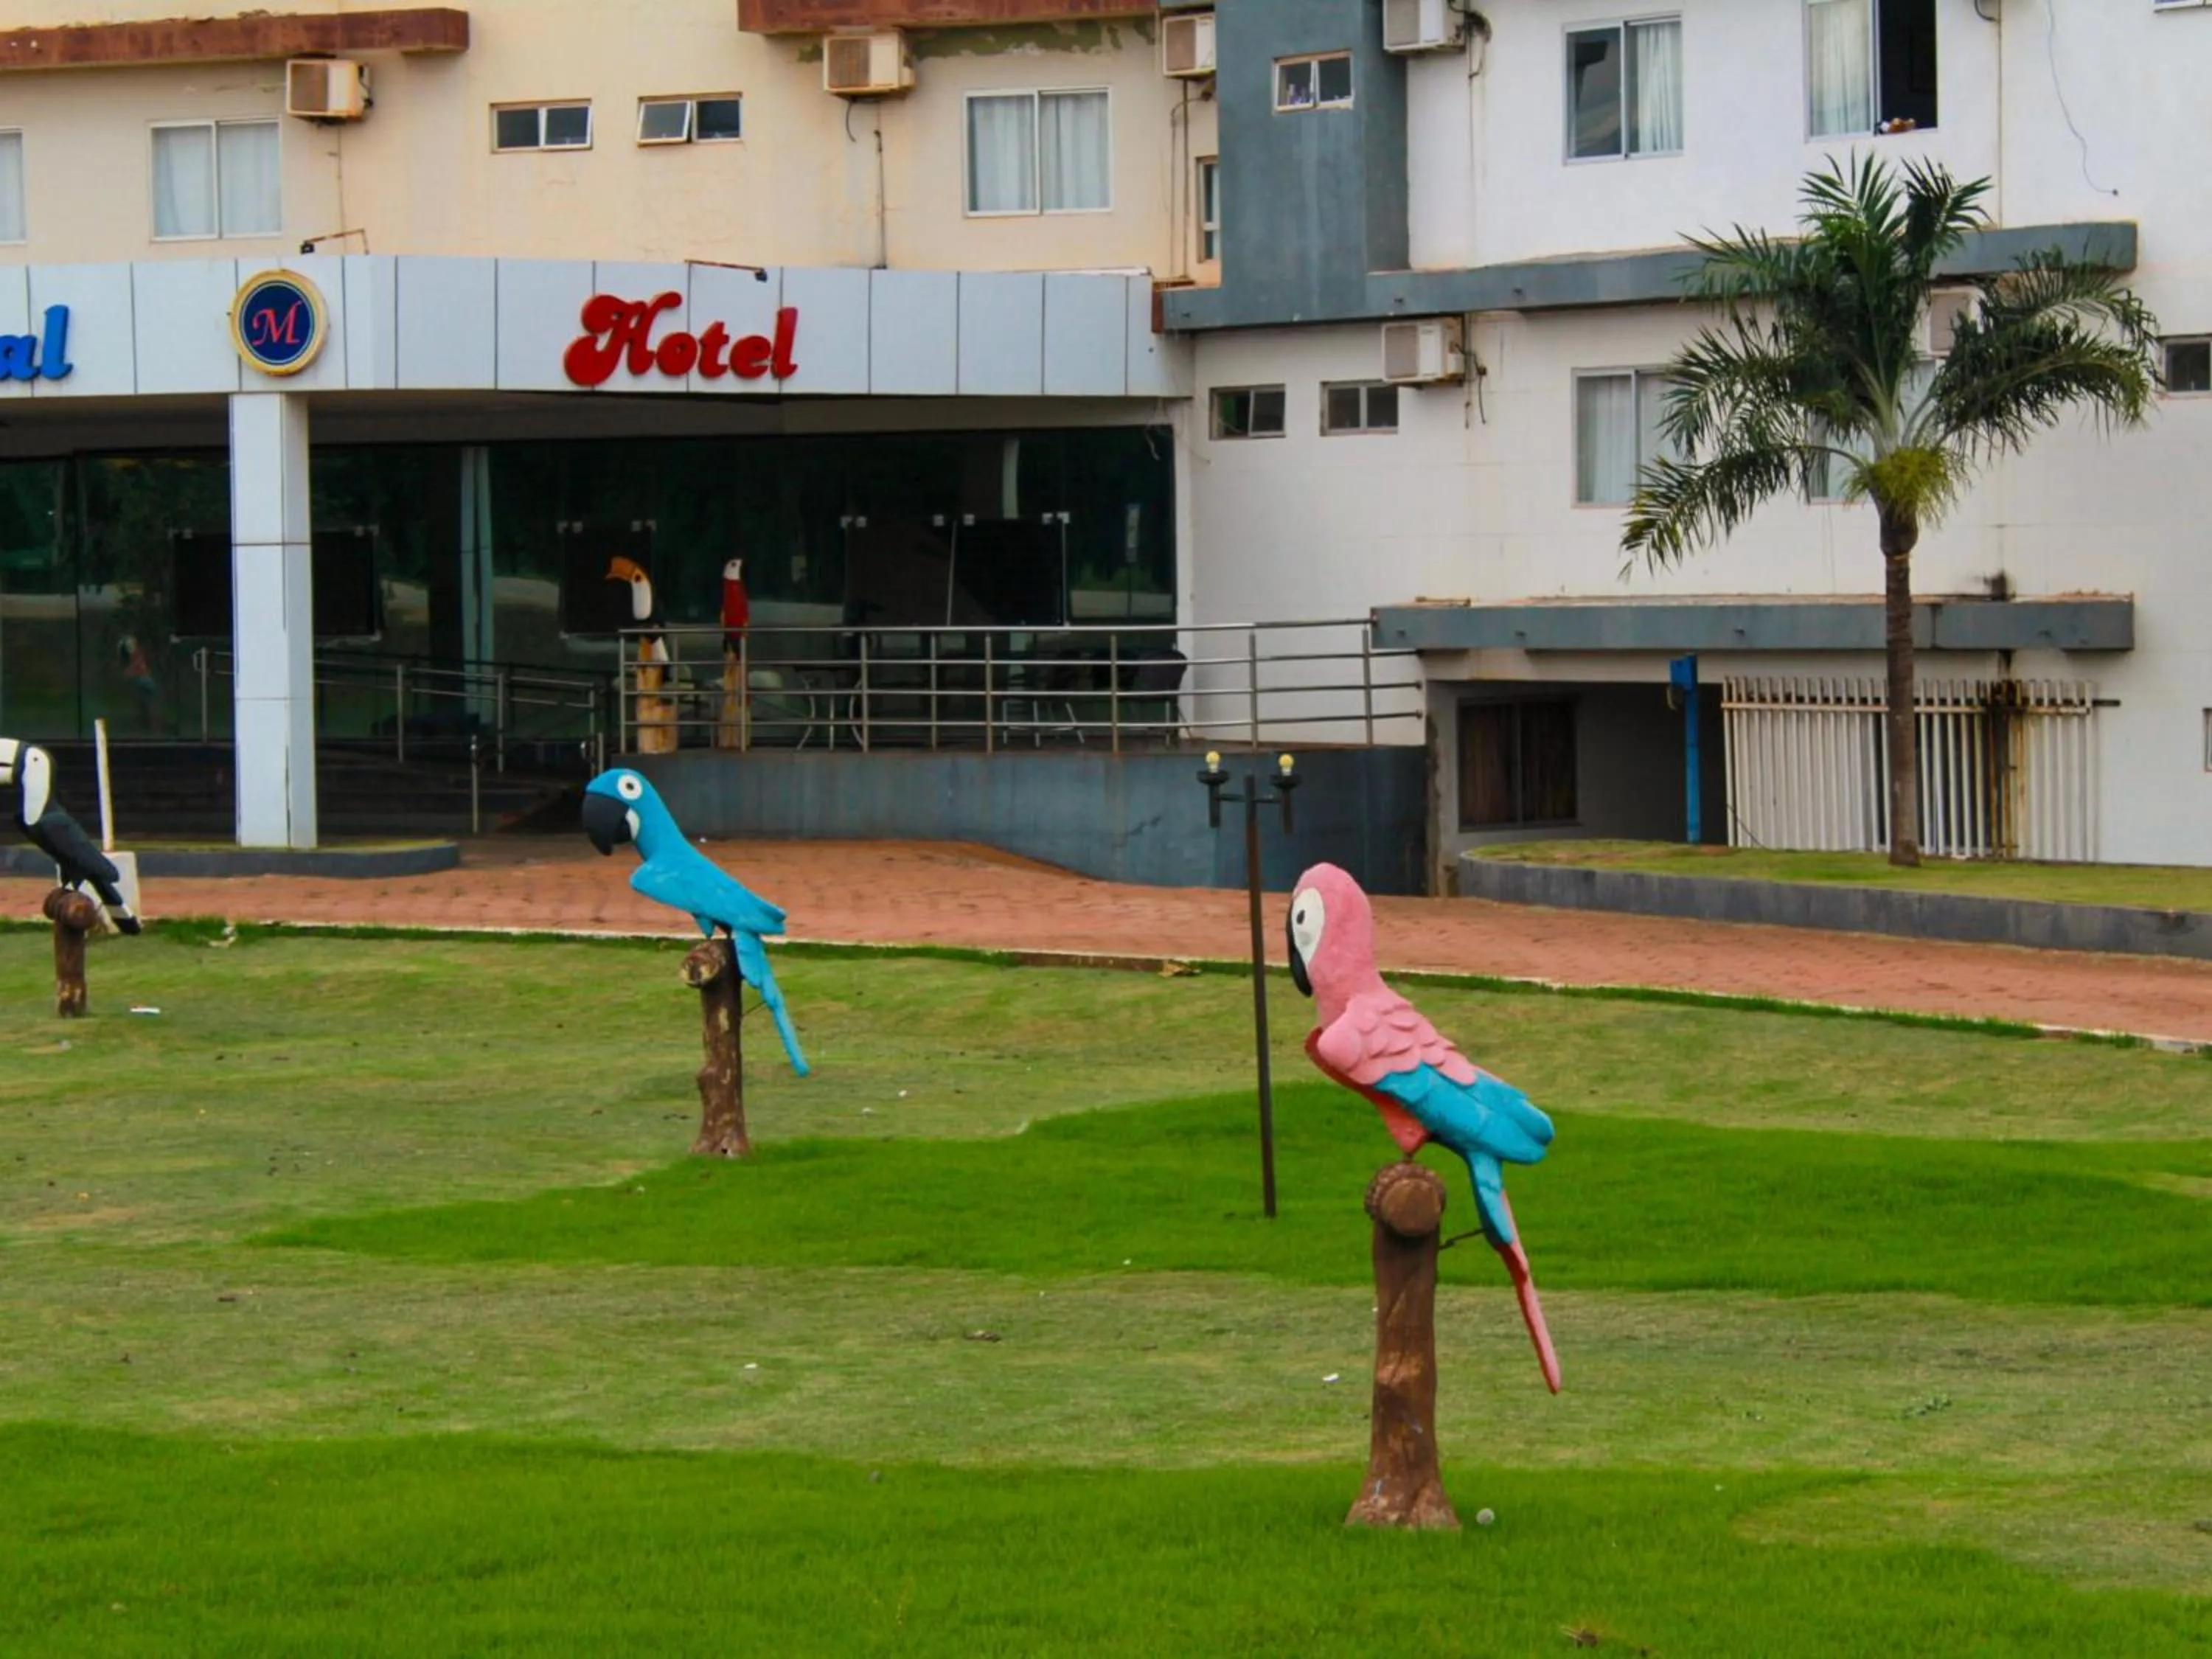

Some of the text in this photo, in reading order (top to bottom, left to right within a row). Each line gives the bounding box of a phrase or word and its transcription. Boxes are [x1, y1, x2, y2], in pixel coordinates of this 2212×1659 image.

[0, 305, 72, 380] al
[251, 301, 302, 345] M
[564, 292, 798, 386] Hotel
